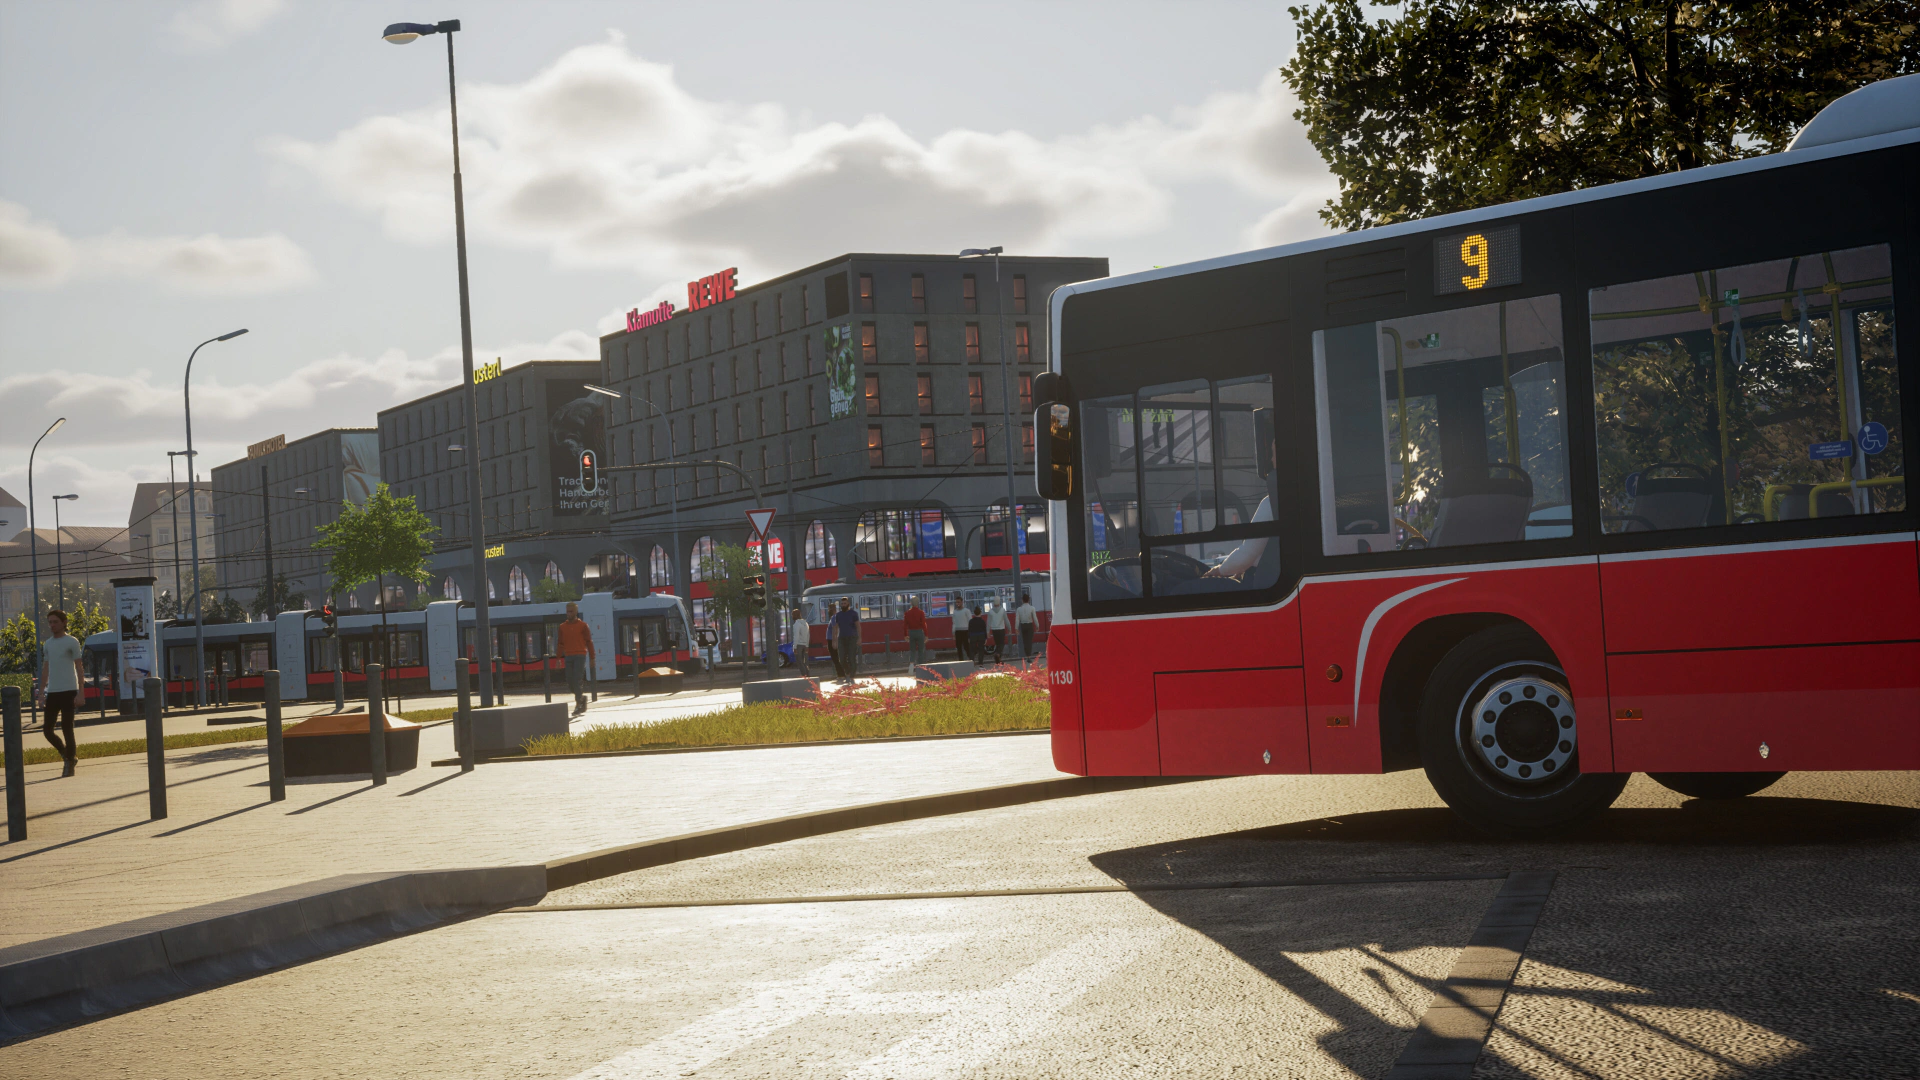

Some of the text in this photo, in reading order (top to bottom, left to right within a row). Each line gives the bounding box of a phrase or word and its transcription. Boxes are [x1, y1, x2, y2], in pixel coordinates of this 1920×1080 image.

[1461, 234, 1488, 290] 9
[687, 267, 738, 312] REWE
[626, 301, 674, 333] Klamotte
[1050, 670, 1073, 685] 1130
